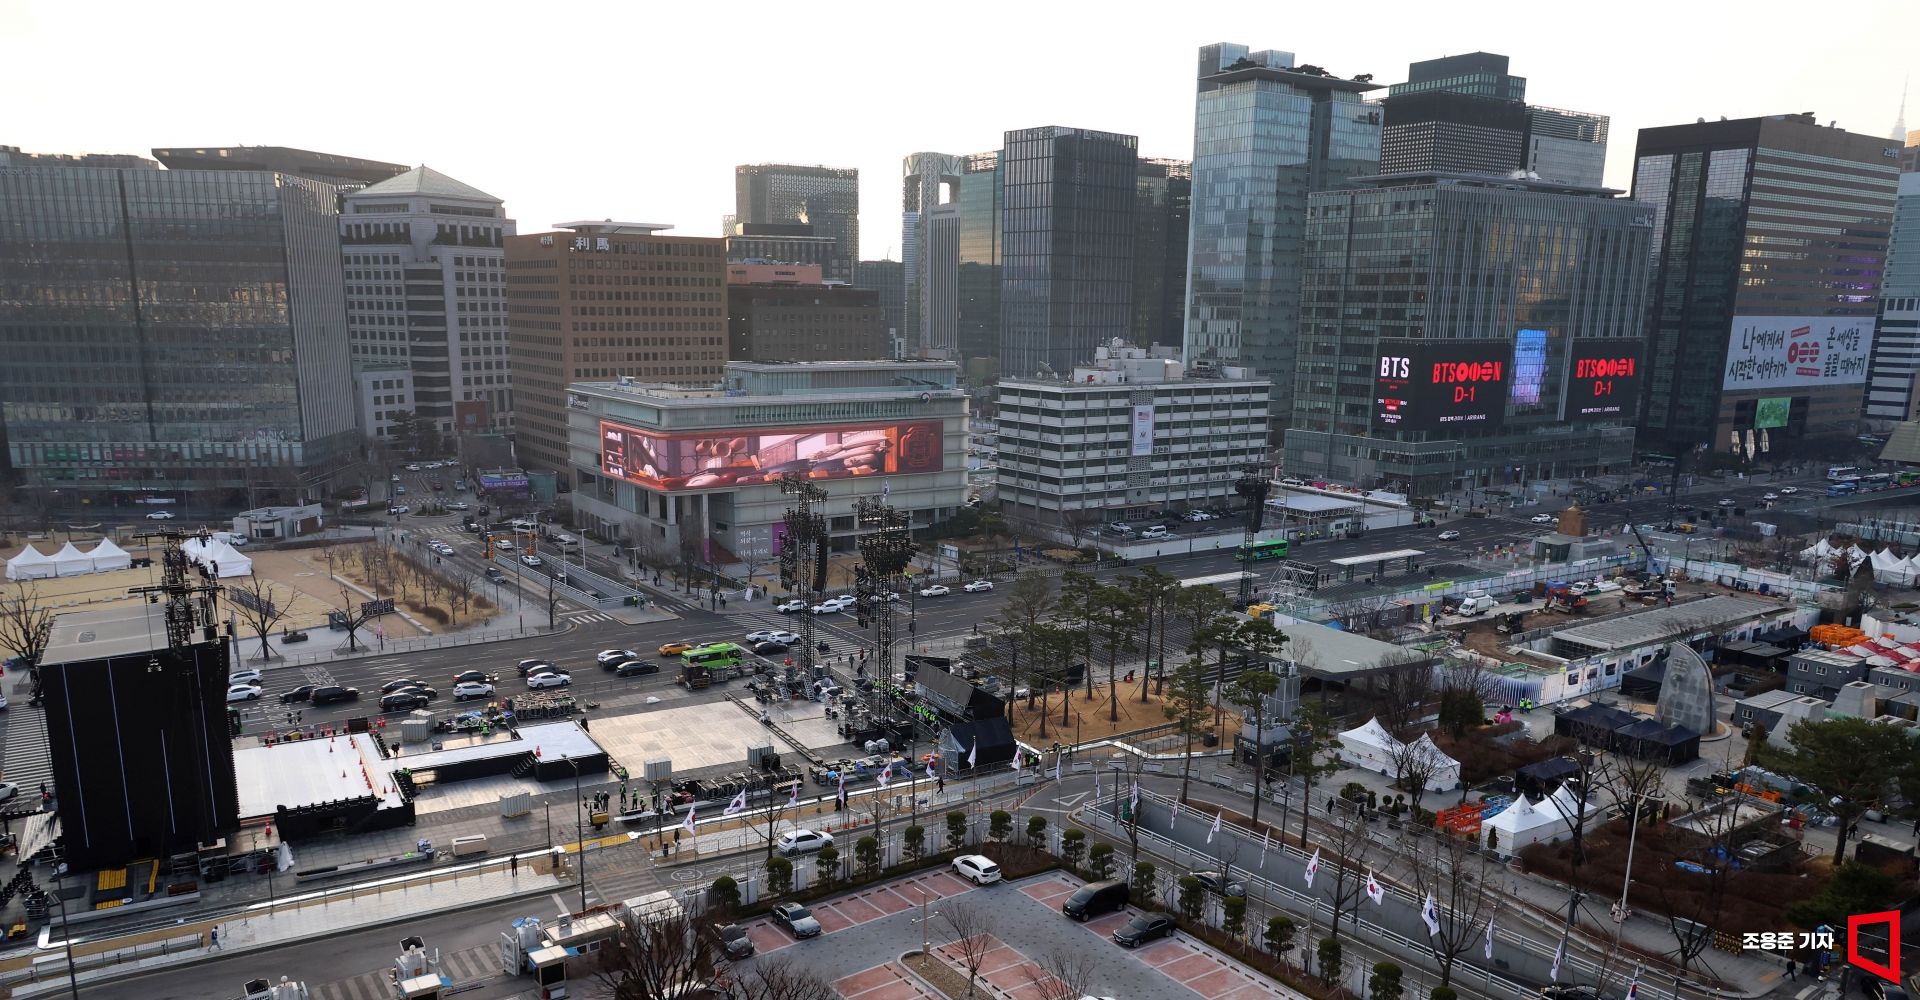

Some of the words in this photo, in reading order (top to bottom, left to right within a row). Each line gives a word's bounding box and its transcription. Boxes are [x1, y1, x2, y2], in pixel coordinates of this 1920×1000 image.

[1742, 326, 1785, 354] 나에게서
[1827, 326, 1836, 350] 온
[1837, 327, 1860, 351] 세상을
[1380, 356, 1410, 378] BTS
[1728, 355, 1756, 381] 시작한
[1757, 356, 1787, 379] 이야기가
[1824, 352, 1840, 377] 울릴
[1840, 353, 1866, 376] 때까지
[1454, 386, 1475, 403] D-1
[1594, 380, 1612, 396] D-1
